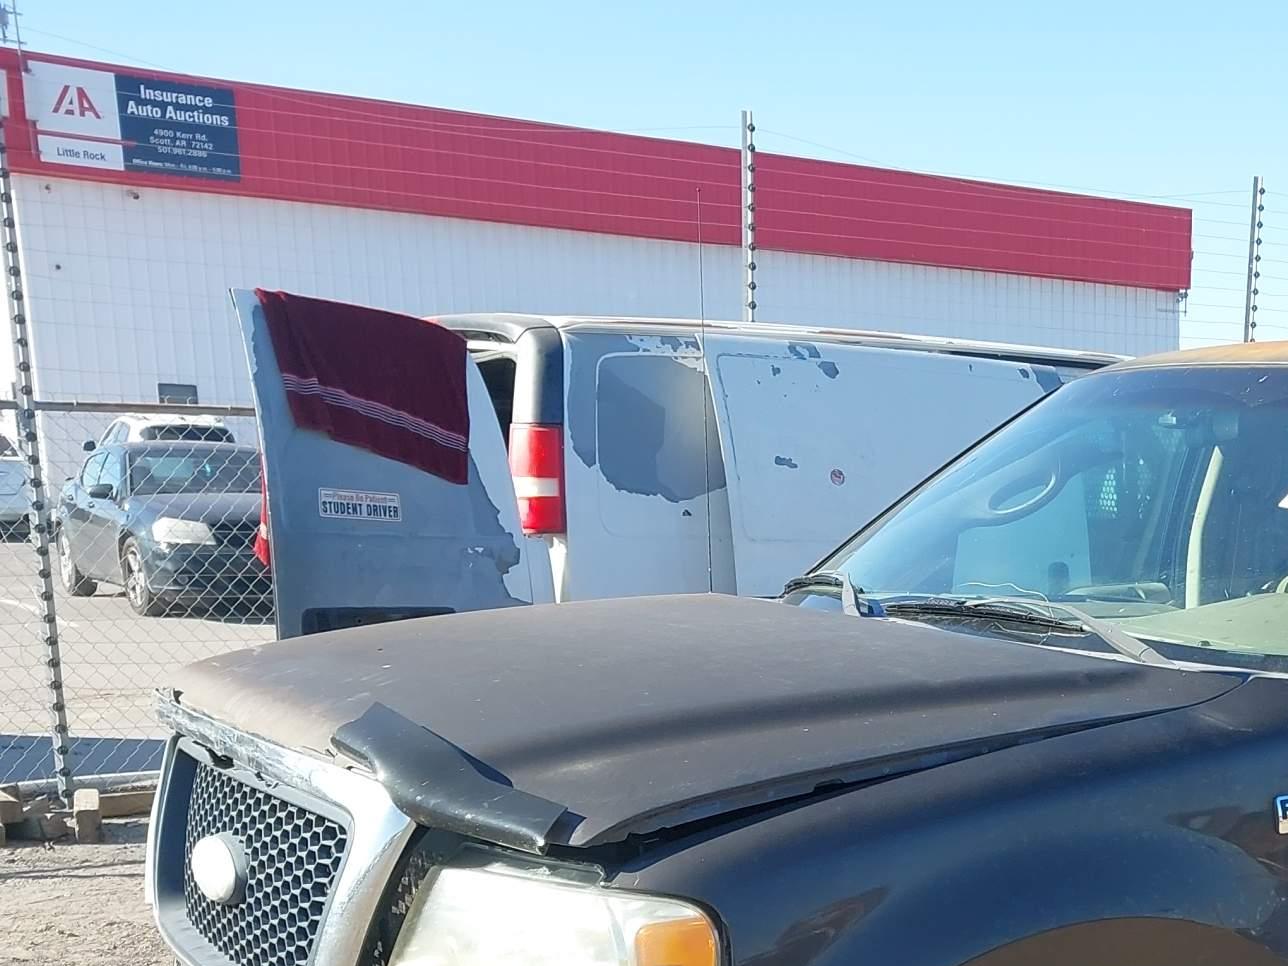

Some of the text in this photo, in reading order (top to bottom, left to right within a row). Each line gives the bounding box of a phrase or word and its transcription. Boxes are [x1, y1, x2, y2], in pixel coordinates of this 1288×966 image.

[140, 84, 213, 107] Insurance
[127, 101, 229, 126] Auto Auctions
[175, 139, 186, 147] AR
[57, 147, 107, 161] Little Rock
[321, 501, 399, 518] STUDENT DRIVER
